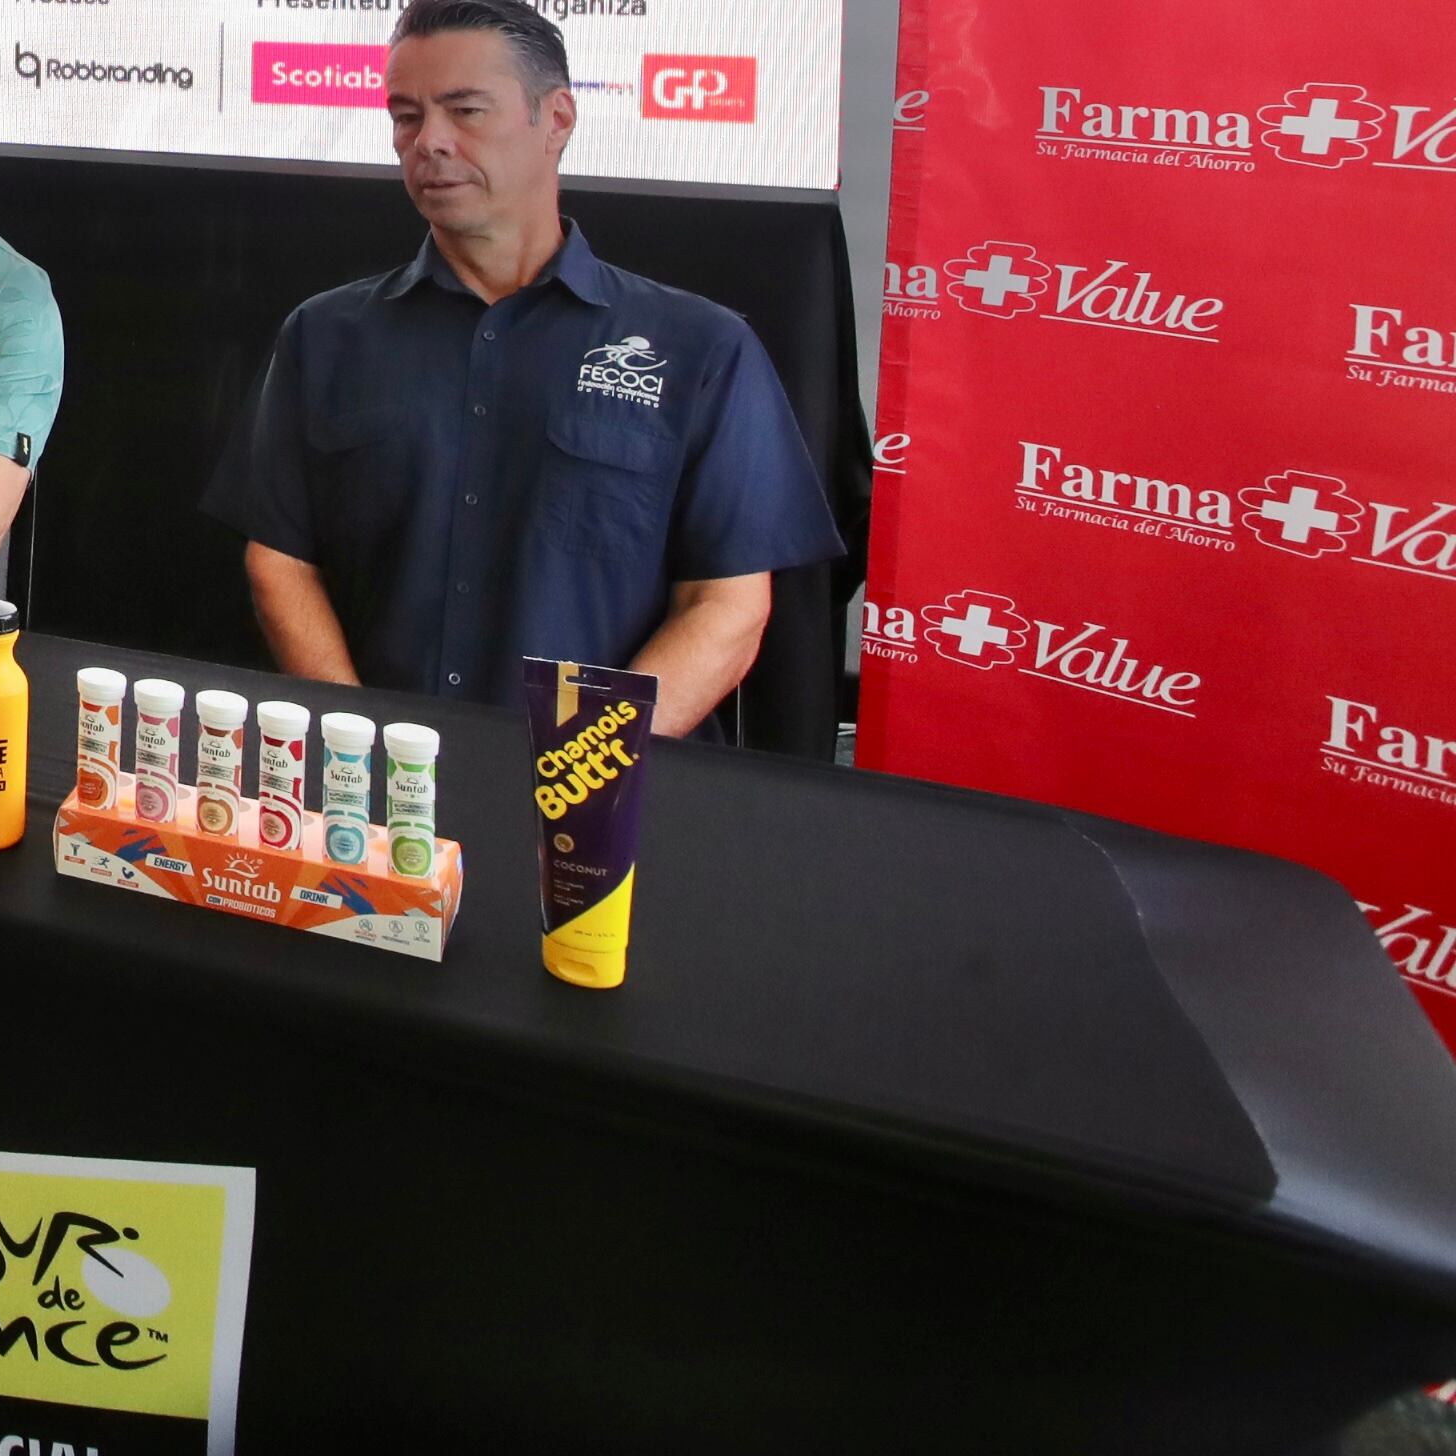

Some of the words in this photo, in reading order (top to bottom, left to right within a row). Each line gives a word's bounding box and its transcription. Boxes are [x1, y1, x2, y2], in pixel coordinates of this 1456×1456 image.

[46, 58, 194, 90] Robbranding
[271, 61, 383, 90] Scotiab
[1037, 86, 1252, 149] Farma
[1037, 142, 1057, 156] Su
[1061, 142, 1149, 166] Farmacia
[1153, 150, 1181, 167] del
[1185, 153, 1255, 174] Ahorro
[1054, 260, 1223, 334] Value
[579, 364, 663, 394] FECOCI
[1346, 365, 1373, 384] Su
[1376, 369, 1456, 394] Farma
[1017, 441, 1235, 529] Farma
[1015, 496, 1037, 513] Su
[1040, 499, 1129, 534] Farmacia
[1133, 516, 1163, 540] del
[1166, 525, 1236, 553] Ahorro
[1034, 620, 1202, 706] Value
[1322, 695, 1456, 777] Far
[330, 769, 363, 784] Suntab
[1321, 755, 1347, 780] Su
[395, 780, 429, 794] Suntab
[153, 856, 188, 873] ENERGY
[553, 859, 608, 877] COCONUT
[201, 867, 282, 904] Suntab
[299, 889, 329, 905] DRINK
[223, 897, 276, 919] PROBIOTICOS
[36, 1275, 85, 1312] de
